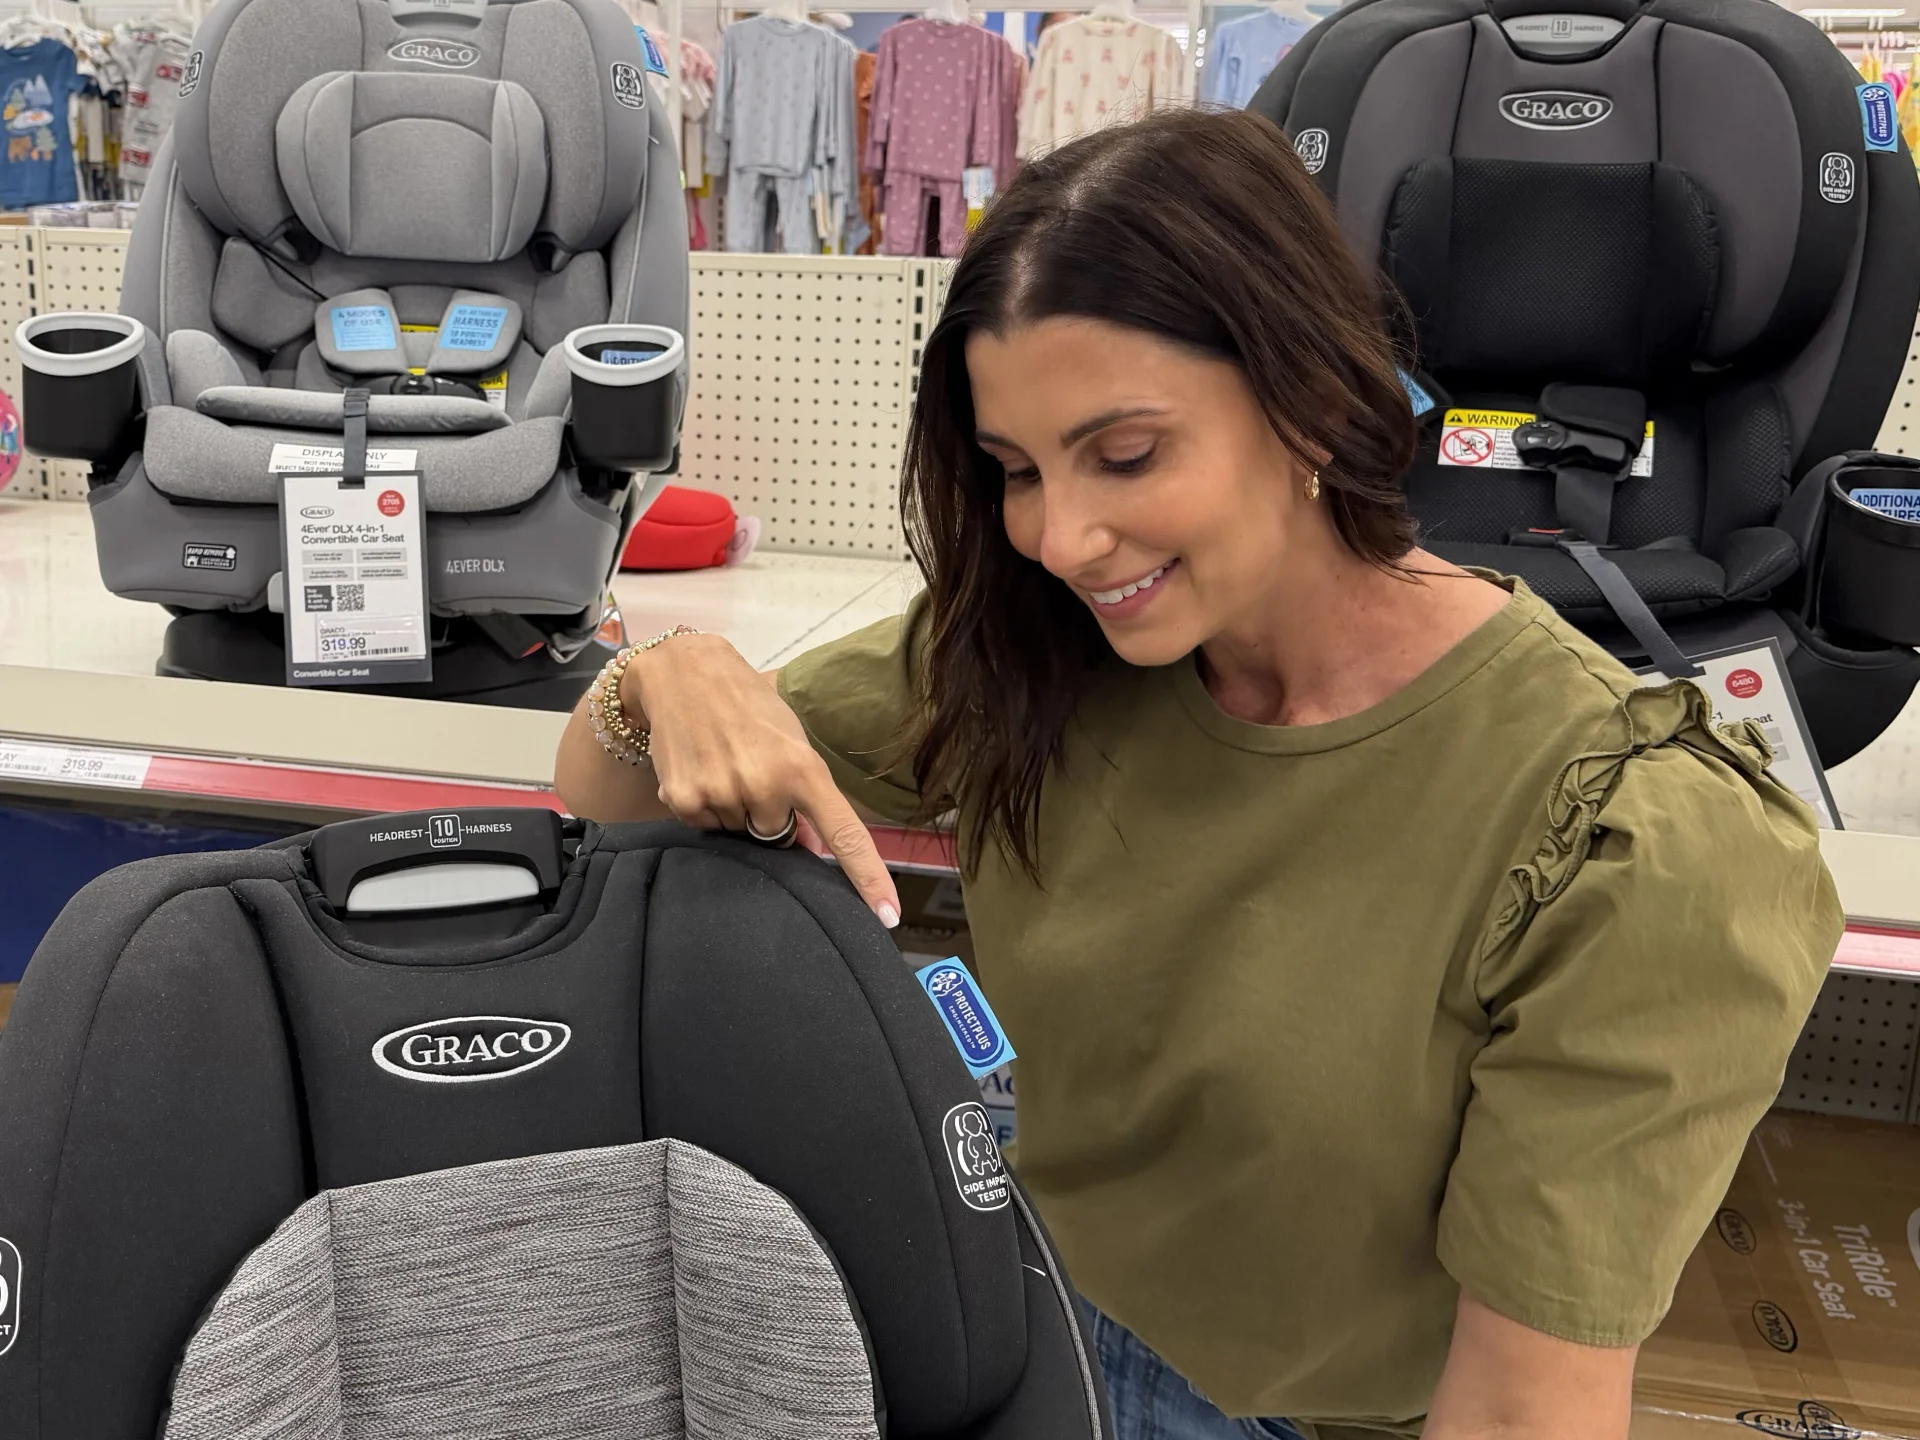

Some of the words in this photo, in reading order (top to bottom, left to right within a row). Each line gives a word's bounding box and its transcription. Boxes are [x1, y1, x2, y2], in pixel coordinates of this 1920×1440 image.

[1556, 20, 1568, 32] 10
[400, 44, 473, 62] GRACO
[1511, 98, 1603, 120] GRACO
[452, 316, 499, 329] HARNESS
[302, 448, 344, 459] DISPLA
[366, 451, 388, 460] NLY
[332, 525, 354, 533] DLX
[355, 524, 385, 533] 4-in-1
[301, 534, 359, 545] Convertible
[361, 534, 380, 544] Car
[381, 534, 405, 543] Seat
[445, 559, 480, 574] 4EVER
[482, 559, 505, 573] DLX
[321, 636, 366, 652] 319.99
[293, 669, 336, 678] Convertible
[337, 669, 351, 677] Car
[352, 668, 370, 677] Seat
[1731, 676, 1755, 688] 6480
[62, 758, 104, 771] 319.99
[369, 828, 424, 843] HEADREST
[434, 818, 454, 837] 10
[465, 822, 513, 835] HARNESS
[433, 837, 458, 845] POSITION
[951, 990, 992, 1051] PROTECTPLUS
[401, 1028, 552, 1066] GRACO
[963, 1180, 986, 1195] SIDE
[986, 1173, 1007, 1189] IMPAC
[977, 1187, 1007, 1203] TESTED
[1777, 1197, 1823, 1246] 3-in-1
[1799, 1248, 1831, 1279] Car
[1813, 1279, 1856, 1321] Seat
